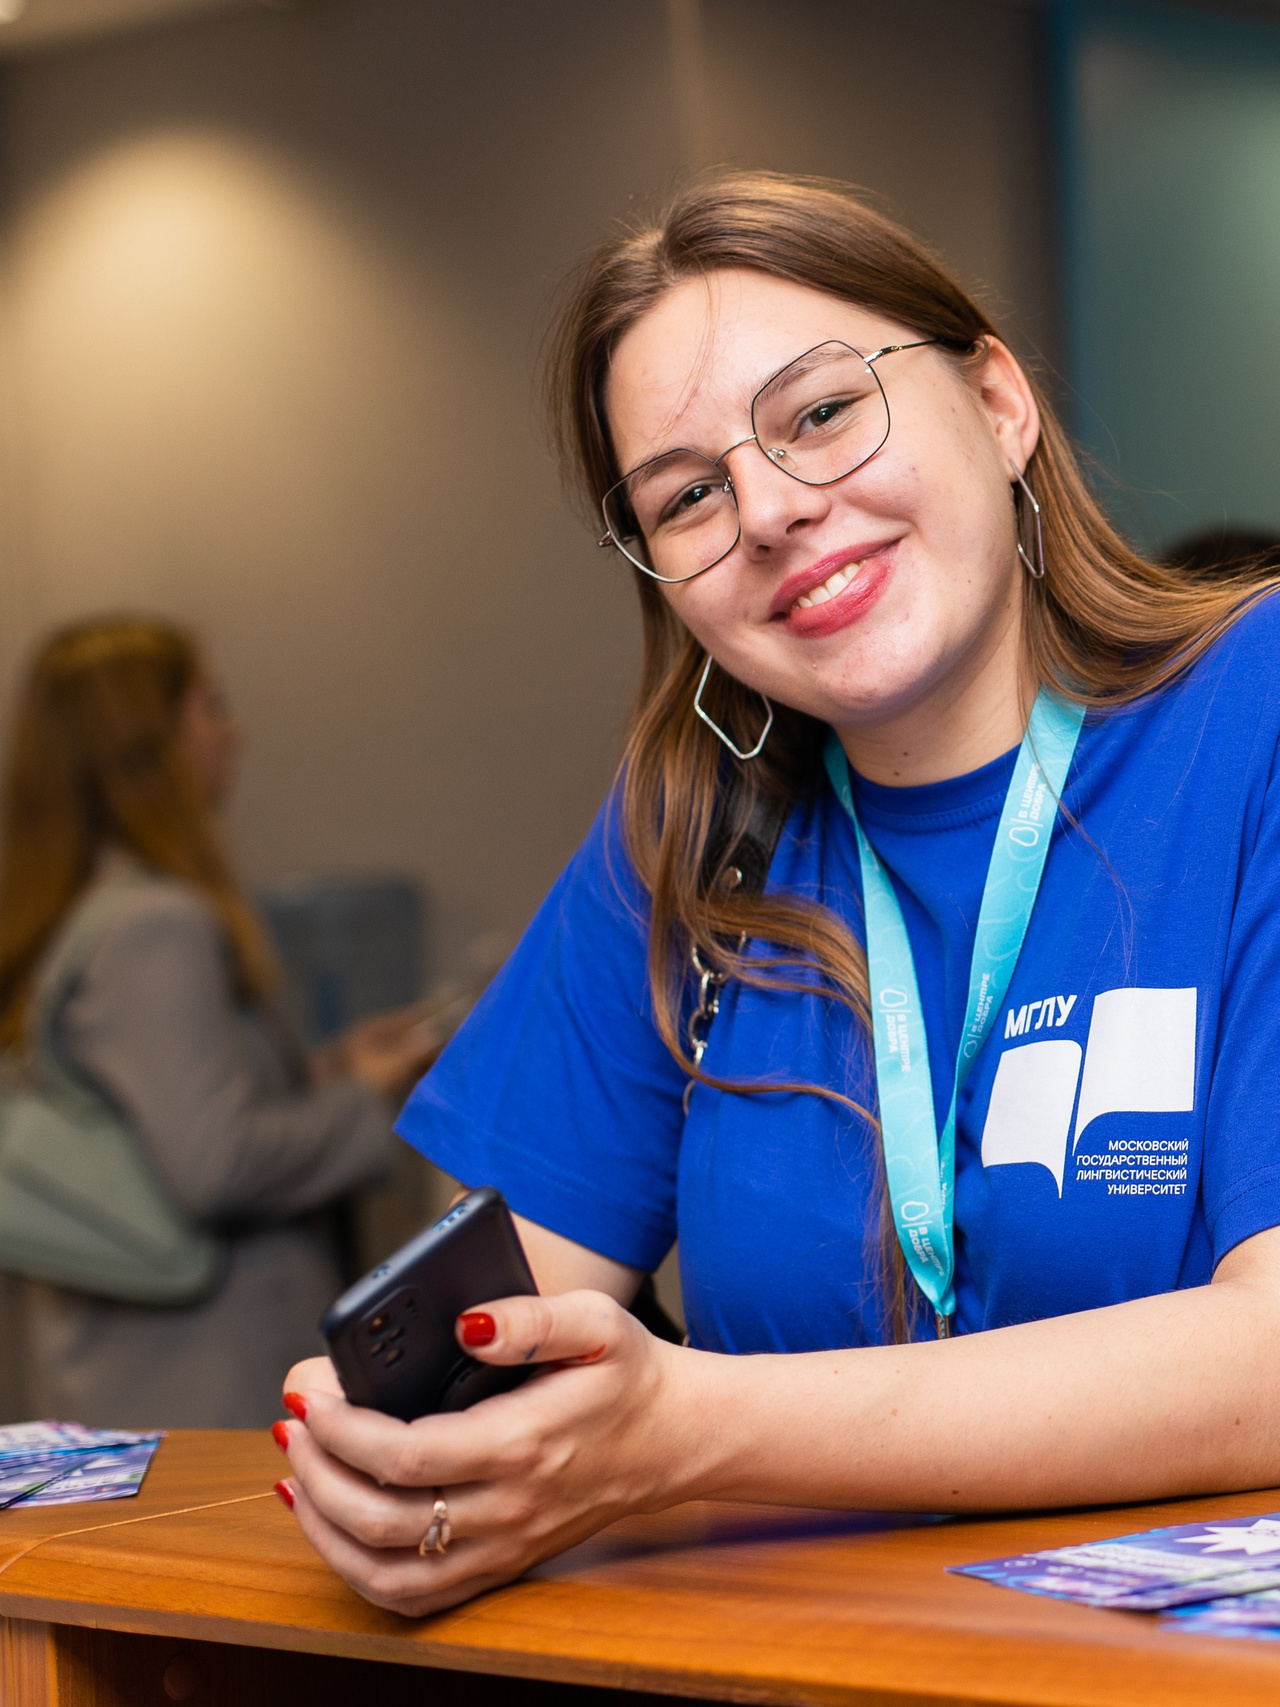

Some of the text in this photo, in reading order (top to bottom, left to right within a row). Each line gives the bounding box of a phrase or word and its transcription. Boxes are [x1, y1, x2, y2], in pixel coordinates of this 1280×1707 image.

[1029, 783, 1047, 821] ДОБРА
[977, 995, 994, 1033] ДОБРА
[1004, 994, 1077, 1039] МГЛУ
[886, 1014, 898, 1053] ДОБРА
[1076, 1153, 1188, 1167] ГОСУДАРСТВЕННЫЙ
[1108, 1138, 1189, 1151] МОСКОВСКИЙ
[1076, 1167, 1187, 1180] ЛИНГВИСТИЧЕСКИЙ
[1107, 1183, 1187, 1195] УНИВЕРСИТЕТ
[908, 1229, 929, 1263] ДОБРА
